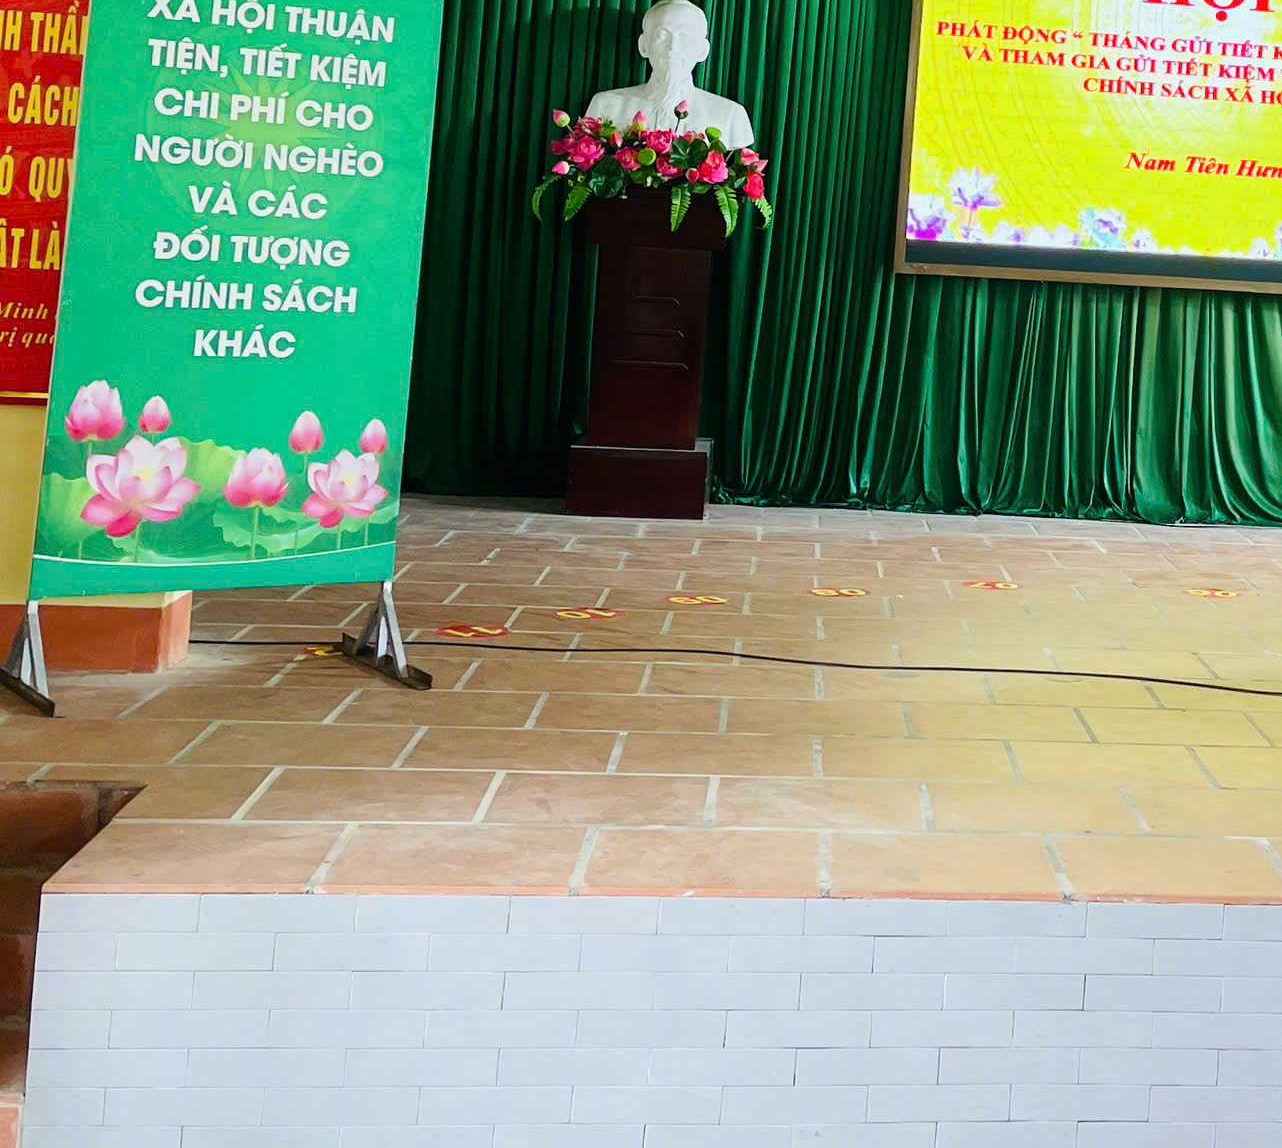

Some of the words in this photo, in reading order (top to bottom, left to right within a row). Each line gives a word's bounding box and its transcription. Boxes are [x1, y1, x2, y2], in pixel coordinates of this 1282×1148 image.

[285, 6, 394, 44] THUẬN
[937, 20, 997, 38] PHÁT
[1003, 26, 1066, 44] ĐỘNG
[1092, 33, 1165, 51] THÁNG
[1172, 36, 1212, 54] GỬI
[1219, 40, 1266, 58] TIẾT
[149, 38, 227, 77] TIỆN,
[240, 44, 301, 78] TIẾT
[310, 54, 386, 89] KIỆM
[1084, 76, 1154, 96] CHÍNH
[1161, 81, 1218, 100] SÁCH
[1225, 86, 1253, 102] XÃ
[155, 88, 219, 119] CHI
[230, 92, 288, 124] PHÍ
[296, 100, 373, 130] CHO
[135, 133, 254, 168] NGƯỜI
[264, 143, 383, 177] NGHÈO
[1125, 153, 1176, 171] Nam
[1186, 156, 1229, 175] Tiên
[189, 181, 237, 215] VÀ
[248, 185, 328, 219] CÁC
[154, 226, 220, 261] ĐỐI
[231, 236, 349, 270] TƯỢNG
[136, 275, 253, 309] CHÍNH
[263, 279, 357, 312] SÁCH
[194, 324, 295, 358] KHÁC
